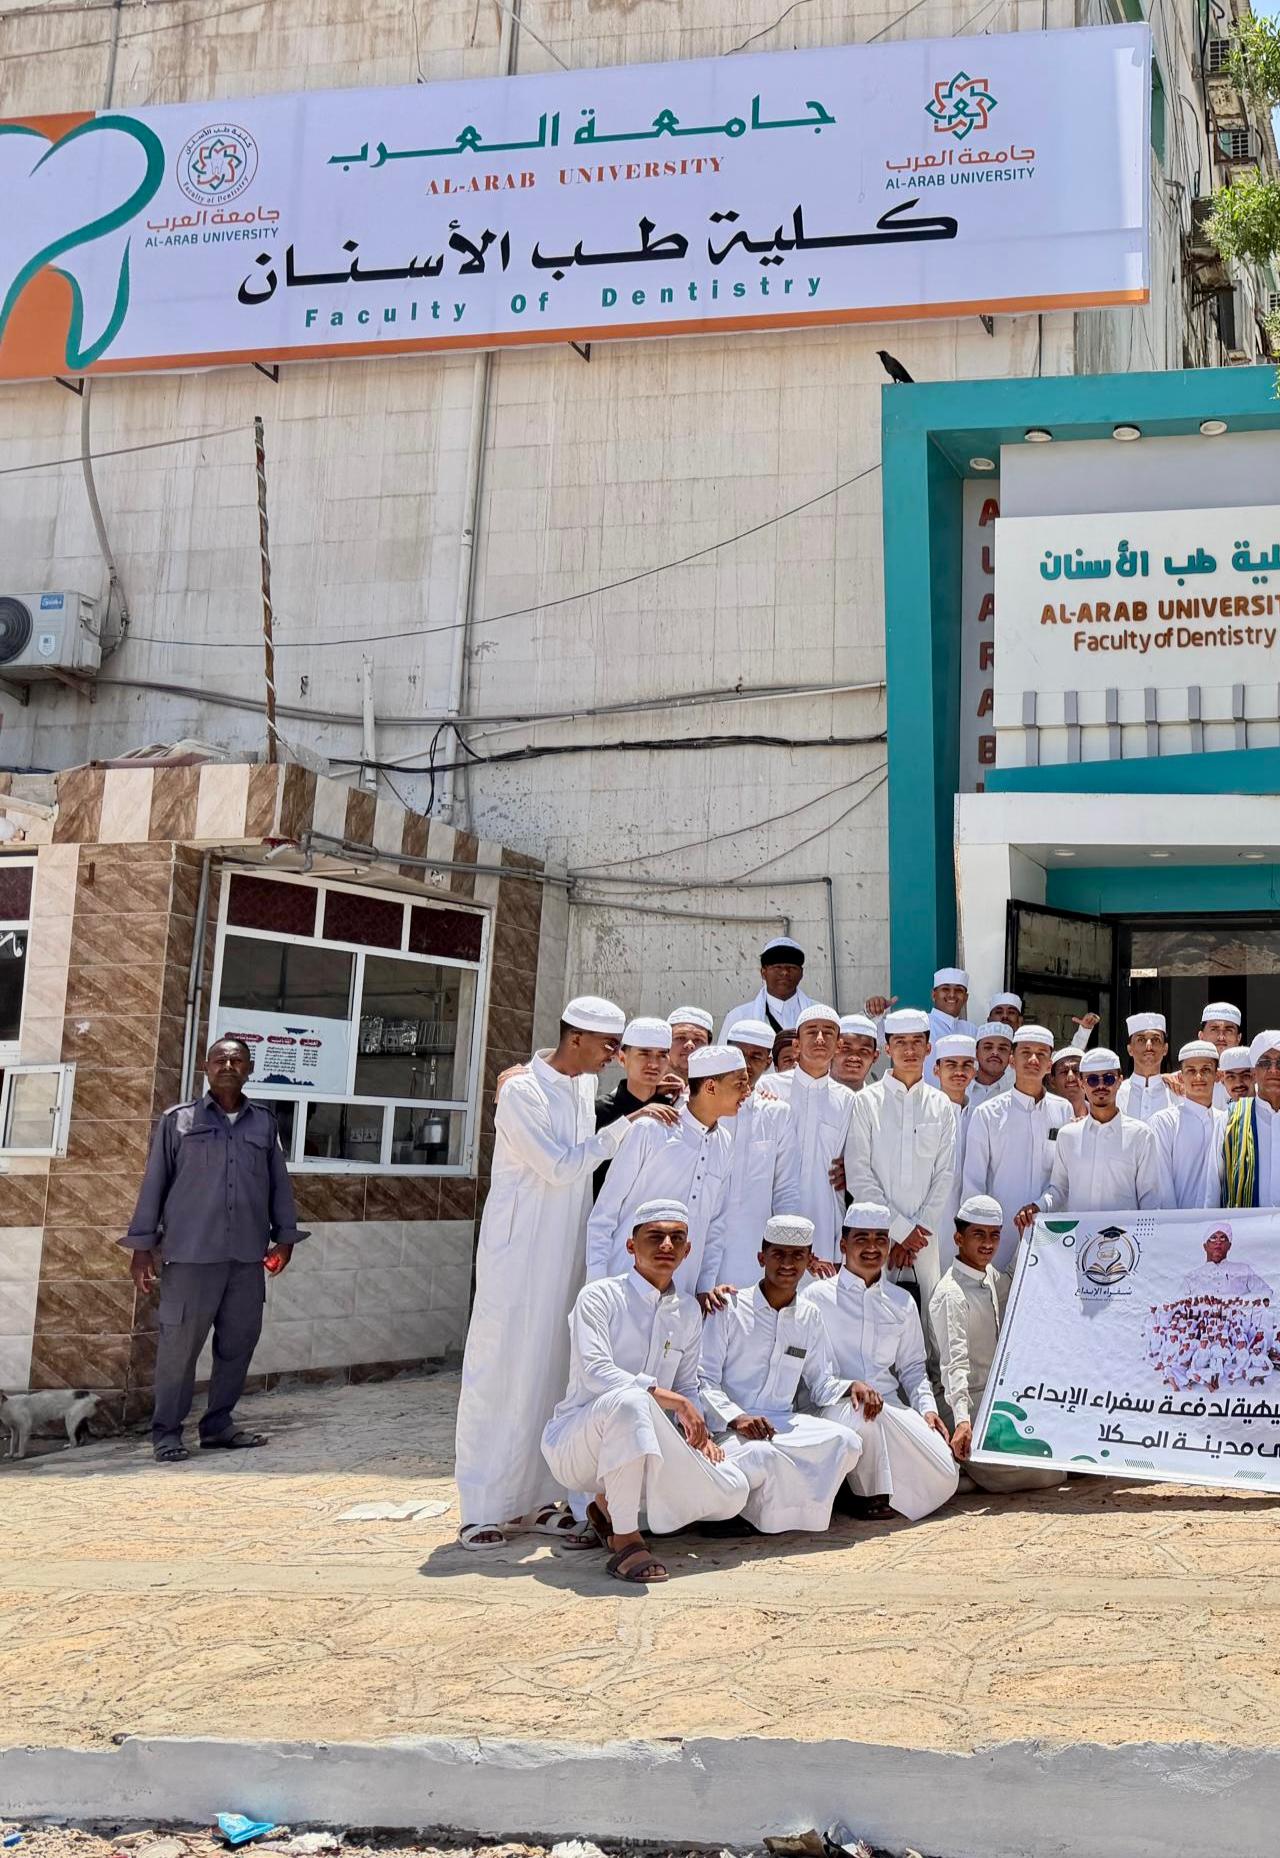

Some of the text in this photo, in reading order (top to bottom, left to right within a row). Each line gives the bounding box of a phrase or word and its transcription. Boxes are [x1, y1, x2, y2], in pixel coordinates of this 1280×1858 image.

[327, 94, 836, 172] جامعة العرب
[886, 145, 1035, 174] جامعة العرب
[427, 157, 724, 195] AL-ARAB UNIVERSITY
[950, 167, 1035, 185] UNIVERSITY
[147, 205, 280, 232] جامعة العرب
[202, 227, 279, 244] UNIVERSITY
[238, 198, 958, 305] كلية طب الأسنان
[305, 276, 821, 328] Faculty Of Dentistry
[1039, 540, 1150, 581] الأسنان
[1163, 547, 1217, 586] طب
[1040, 600, 1148, 625] AL-ARAB
[1074, 624, 1277, 654] Faculty of Dentistry
[1016, 1382, 1089, 1413] الإبداع
[1089, 1391, 1155, 1415] سفراء
[1158, 1395, 1231, 1418] لدفعة
[1097, 1423, 1170, 1449] المكلا
[1171, 1431, 1254, 1459] مدينة
